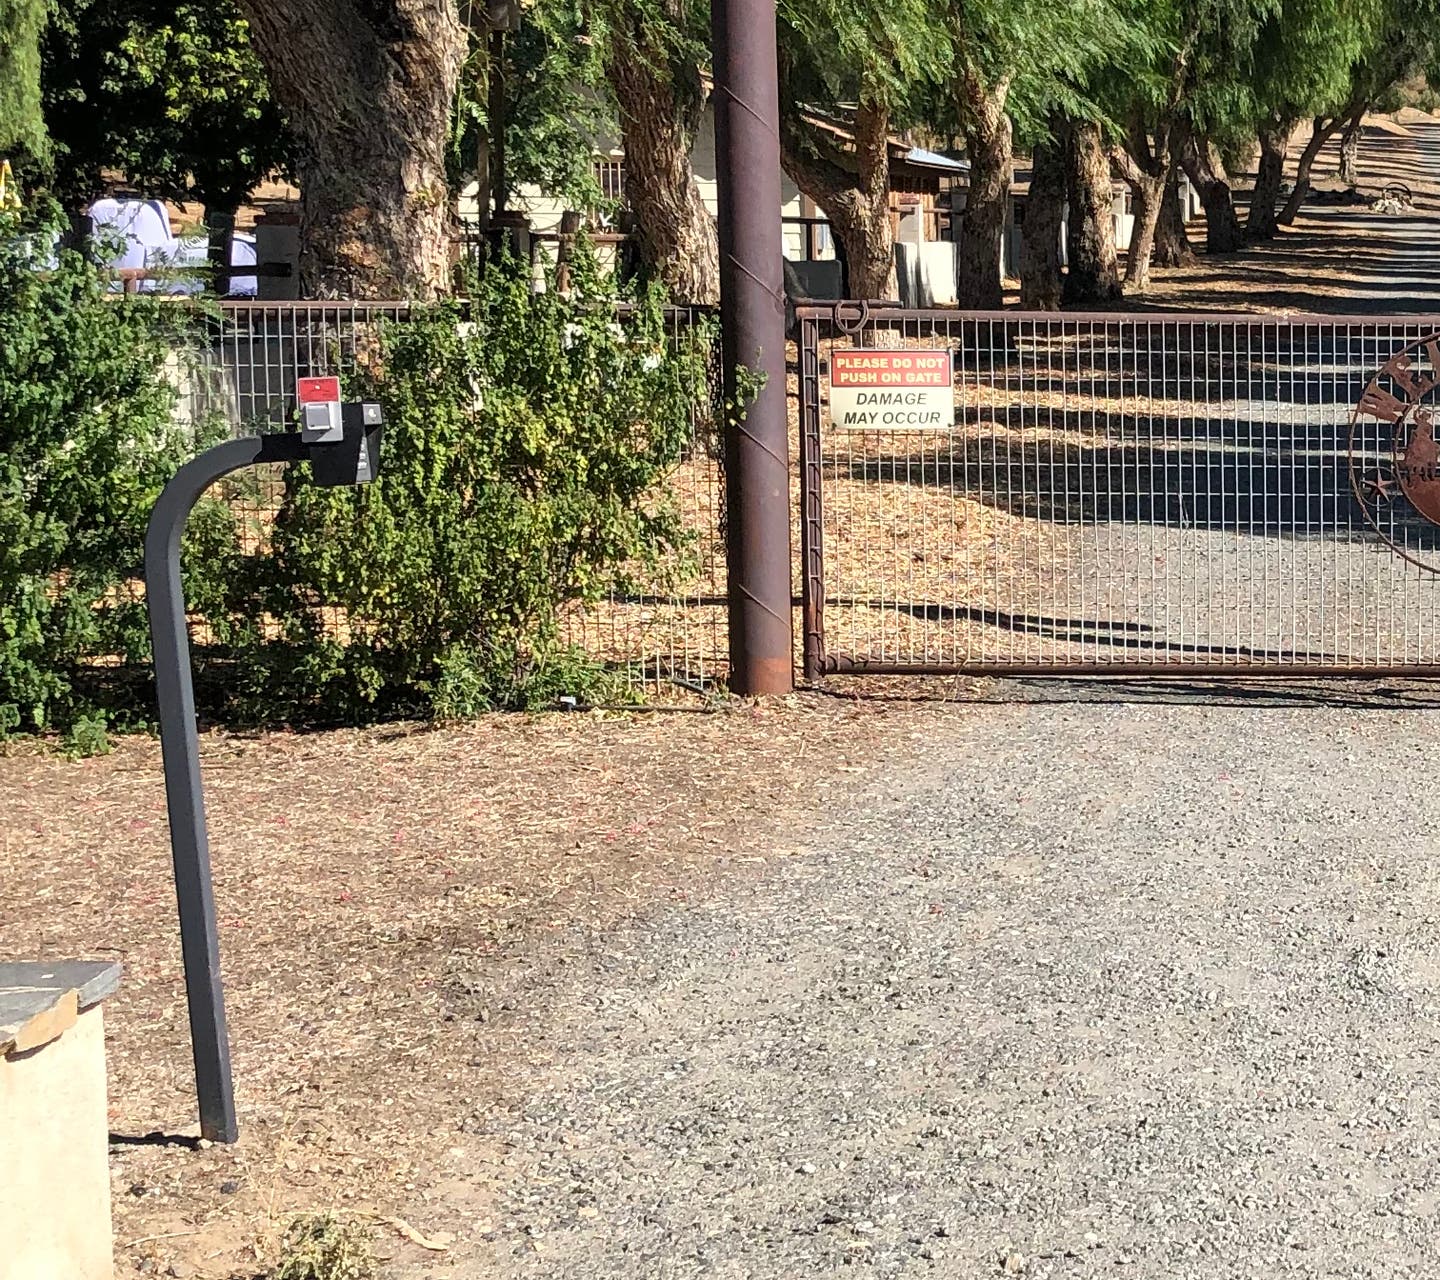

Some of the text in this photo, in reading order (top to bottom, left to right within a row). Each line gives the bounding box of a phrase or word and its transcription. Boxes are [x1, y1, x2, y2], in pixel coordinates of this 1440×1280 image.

[836, 357, 945, 368] PLEASE DO NOT
[840, 373, 942, 383] PUSH ON GATE
[856, 392, 928, 406] DAMAGE
[843, 411, 941, 425] MAY OCCUR
